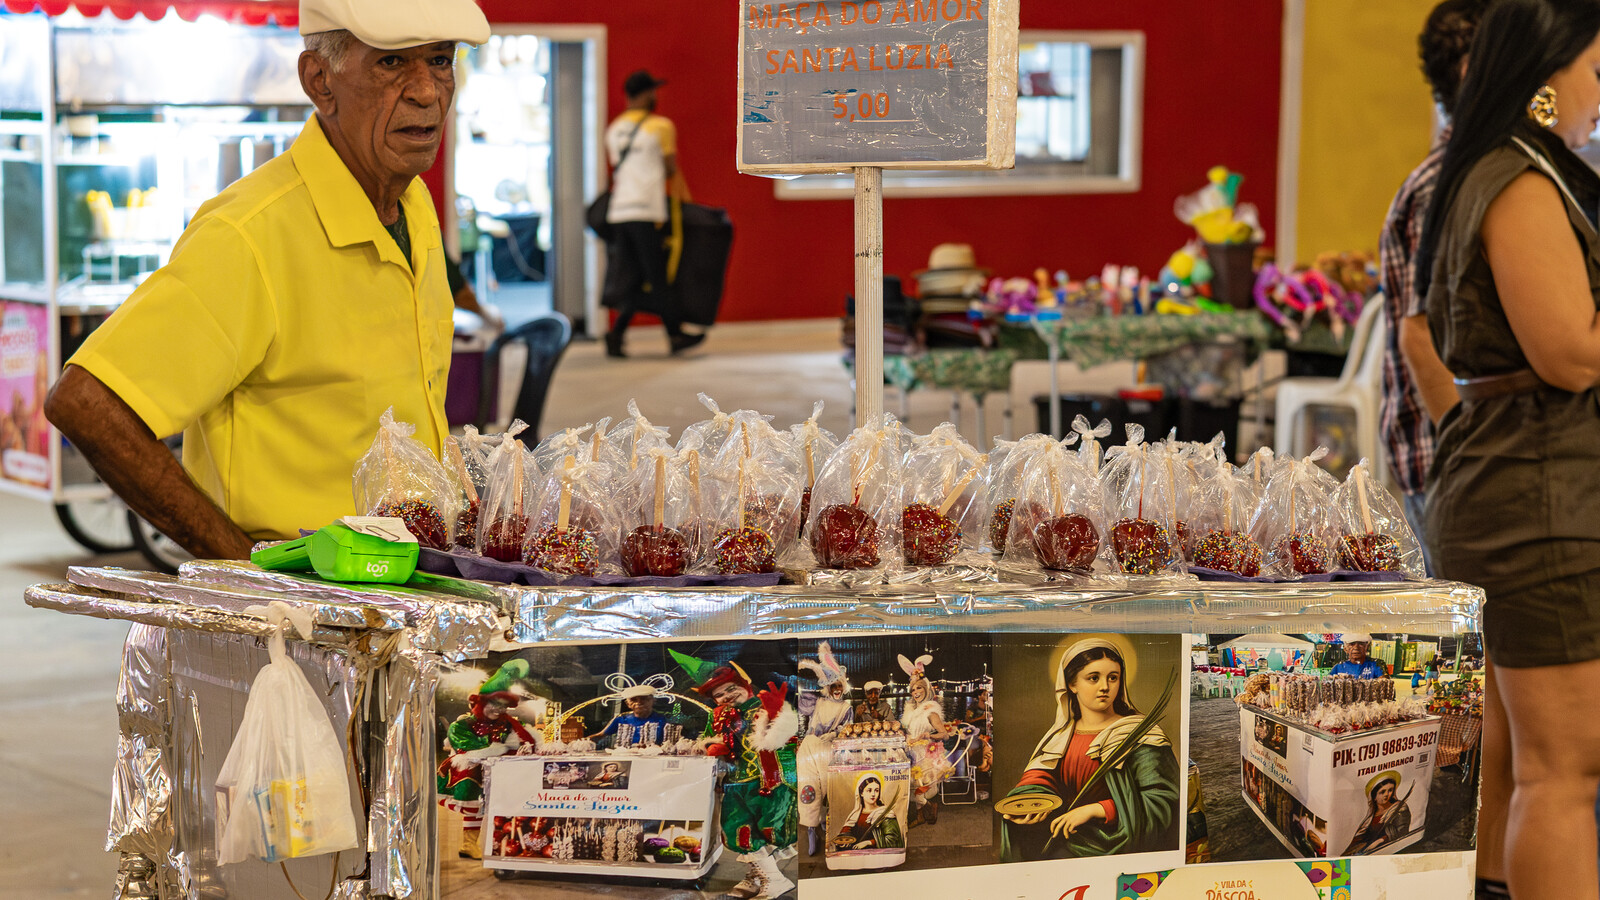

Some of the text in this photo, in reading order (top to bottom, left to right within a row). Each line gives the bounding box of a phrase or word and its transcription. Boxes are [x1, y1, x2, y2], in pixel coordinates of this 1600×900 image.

[841, 0, 882, 25] DO
[891, 0, 984, 23] AMOR
[765, 43, 955, 75] SANTA LUZIA
[833, 93, 890, 123] 5,00
[366, 561, 388, 574] ton
[1333, 730, 1438, 768] PIX: (79) 98839-3921
[1357, 756, 1414, 777] ITAU UNIBANCO
[1220, 880, 1247, 889] VILA DA
